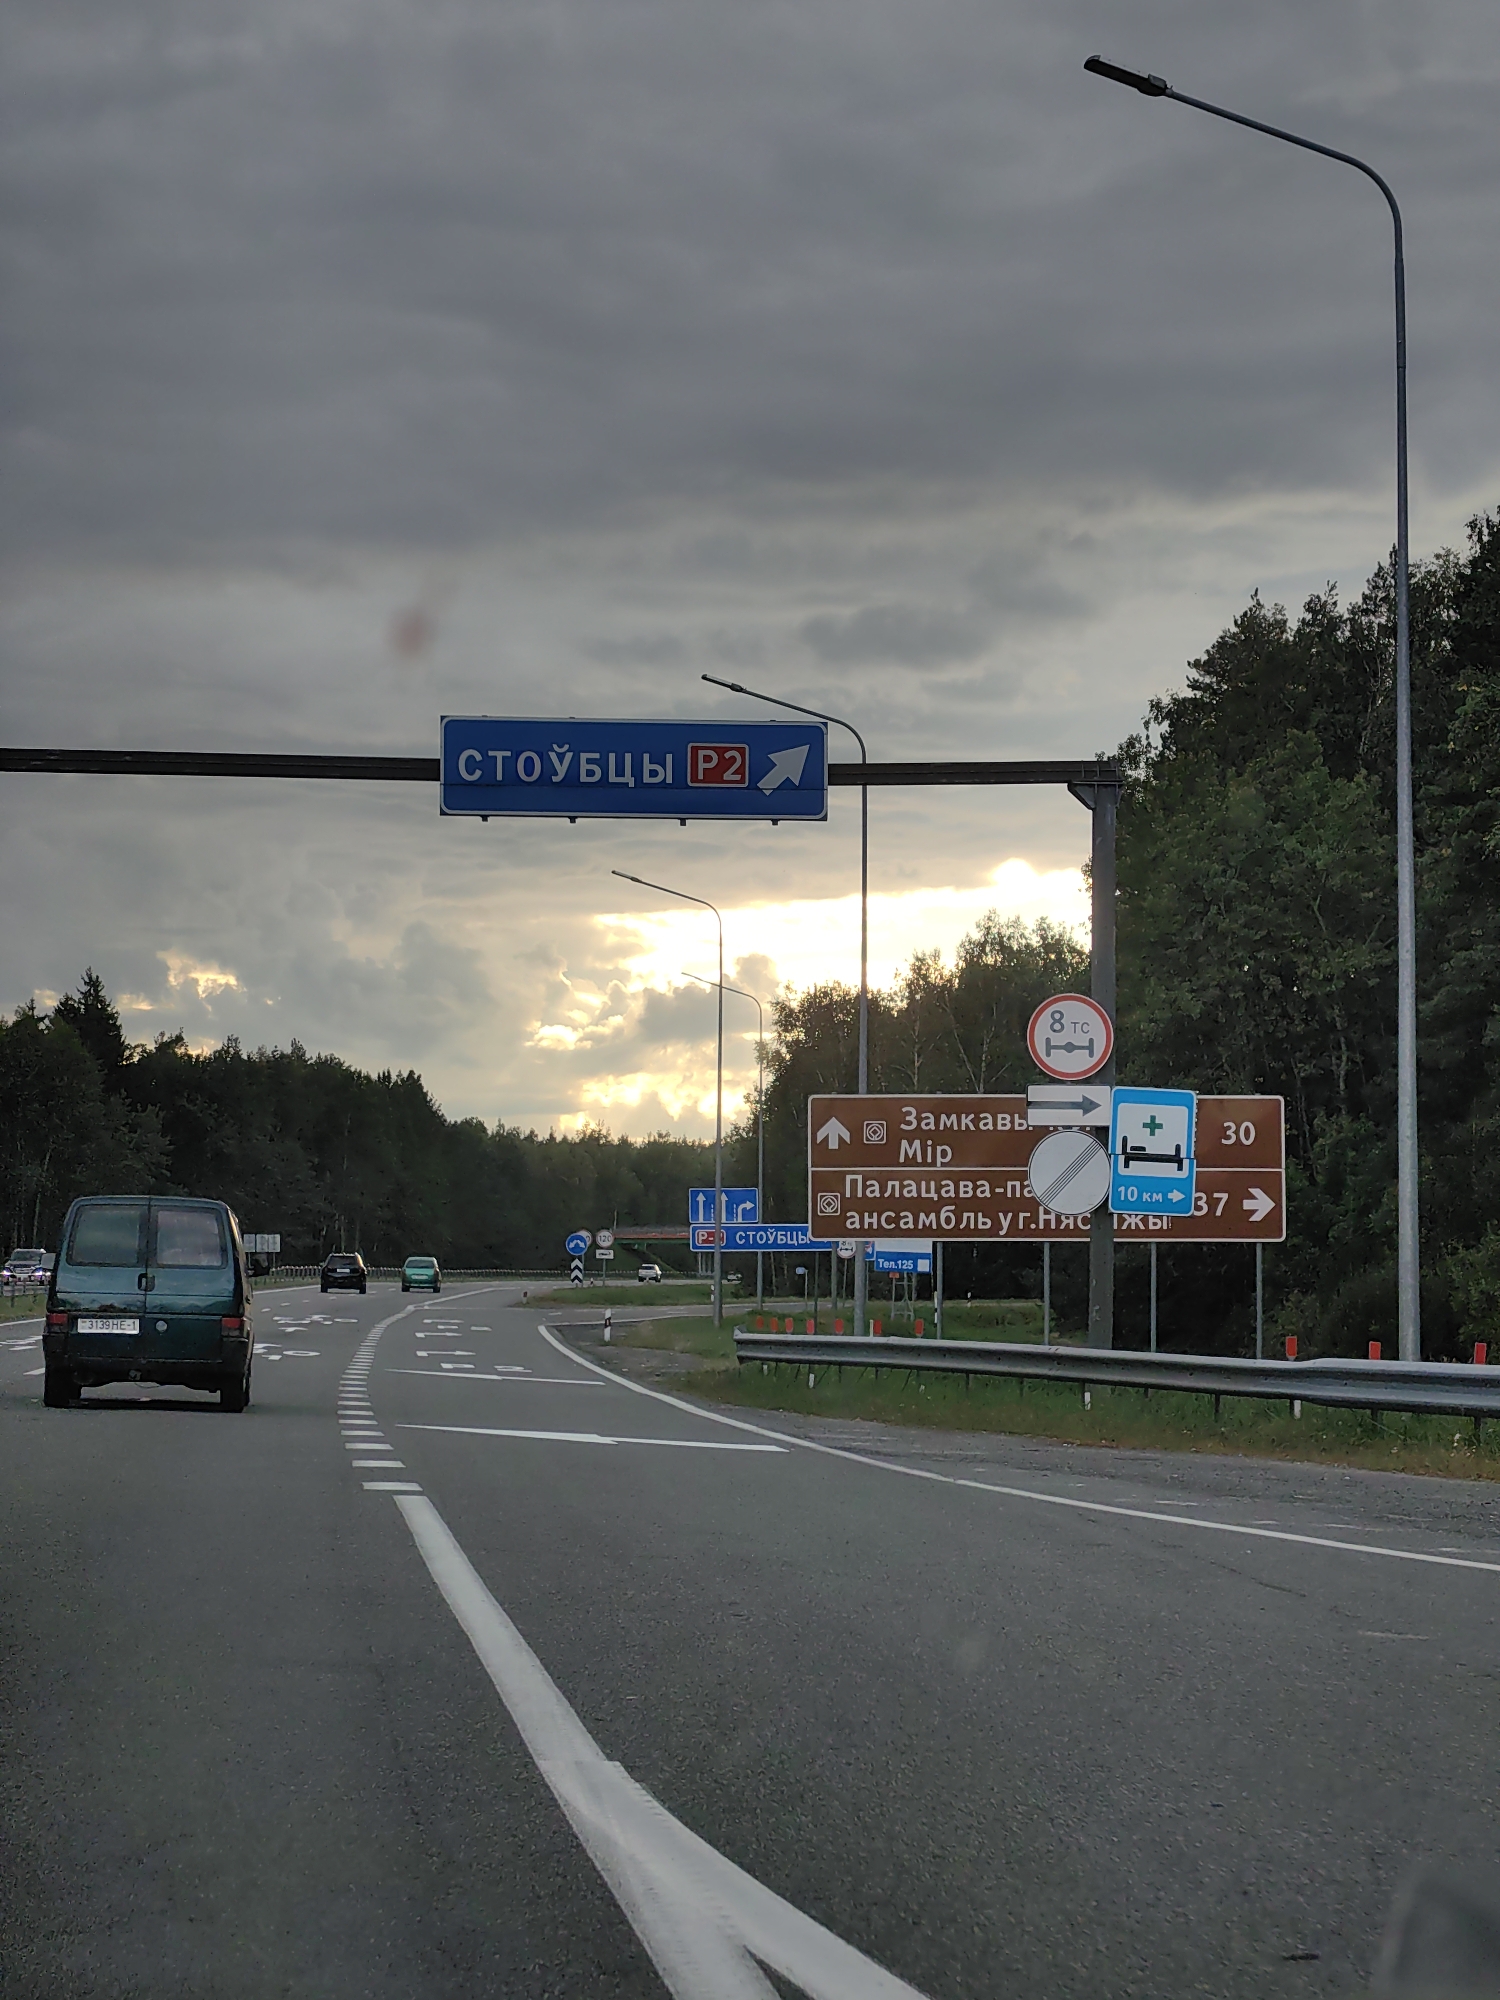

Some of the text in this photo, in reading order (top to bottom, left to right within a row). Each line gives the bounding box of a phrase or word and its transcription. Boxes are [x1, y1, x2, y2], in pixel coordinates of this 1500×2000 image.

[458, 743, 743, 787] СТОЎБЦЫ Р2
[1049, 1009, 1065, 1034] 8
[1222, 1121, 1256, 1146] 30
[899, 1139, 953, 1168] Мір
[844, 1174, 1035, 1200] Палацава-па
[1117, 1186, 1163, 1203] 10 км
[1193, 1192, 1228, 1217] 37
[845, 1205, 992, 1230] ансамбль
[598, 1235, 611, 1243] 120
[735, 1228, 810, 1246] СТОЎБЦЫ
